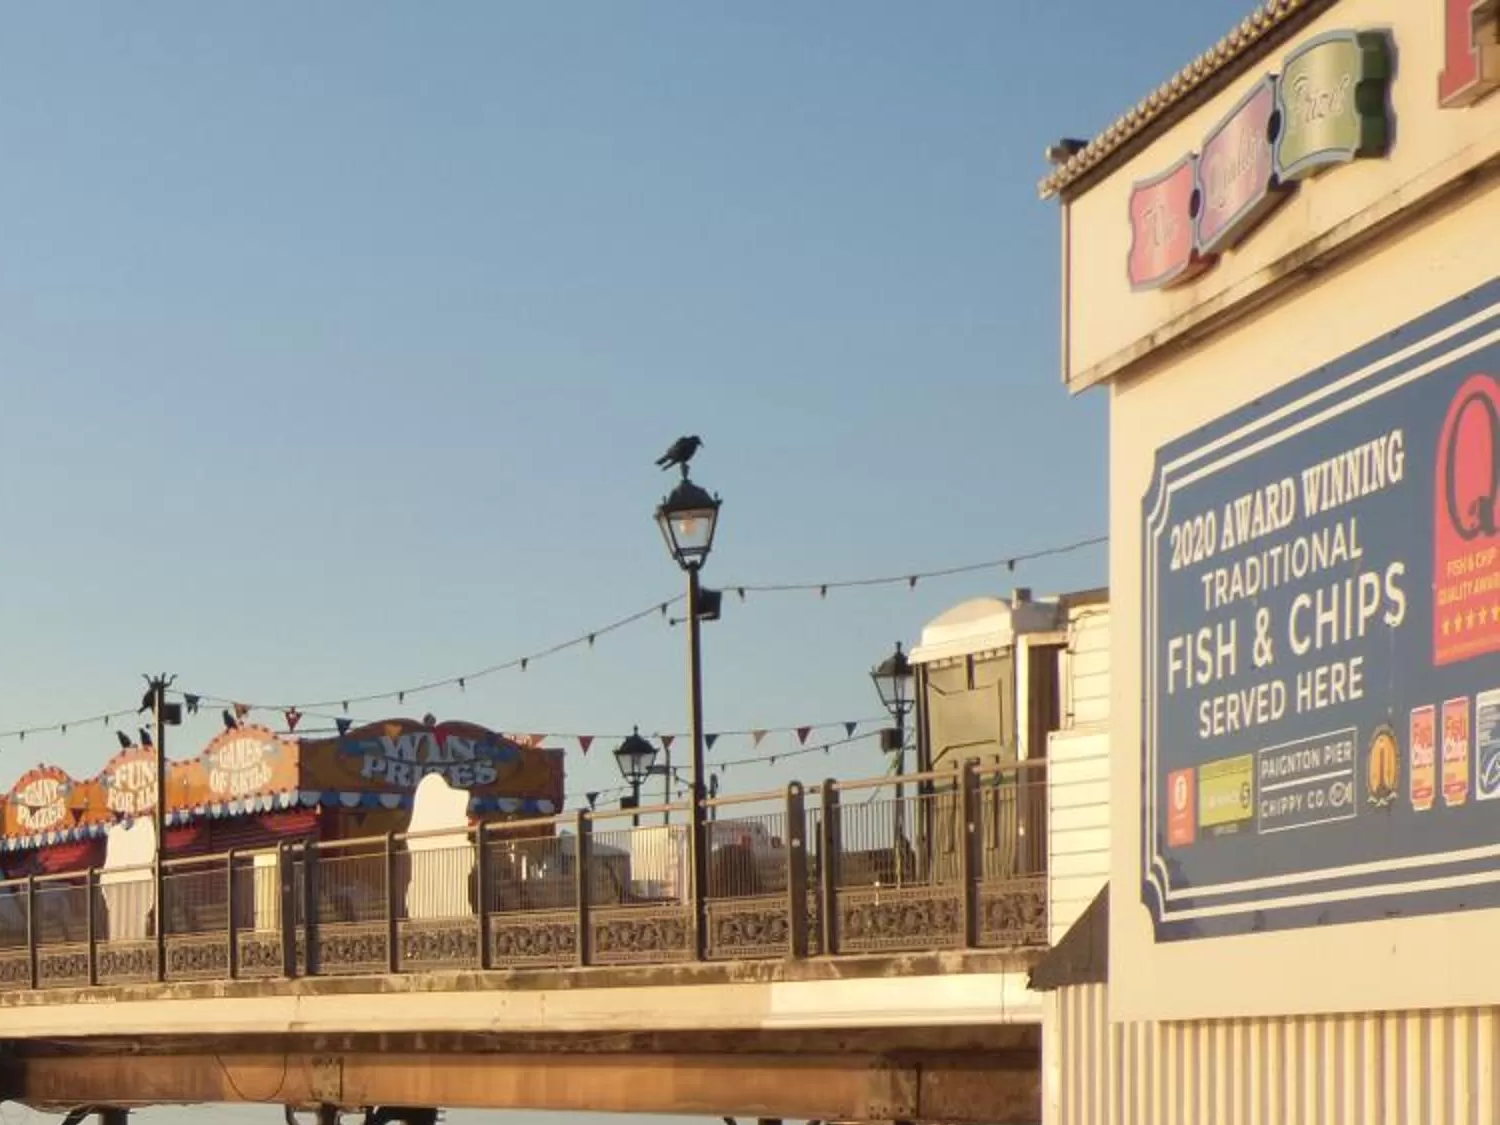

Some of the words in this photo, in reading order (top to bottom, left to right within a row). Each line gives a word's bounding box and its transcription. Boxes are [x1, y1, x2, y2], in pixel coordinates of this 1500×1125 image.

[1170, 509, 1217, 571] 2020
[1220, 477, 1296, 551] AWARD
[1301, 429, 1405, 518] WINNING
[1201, 517, 1364, 611] TRADITIONAL
[1167, 619, 1237, 695] FISH
[1252, 607, 1274, 668] &
[1288, 561, 1407, 656] CHIPS
[1198, 680, 1286, 739] SERVED
[1296, 656, 1364, 714] HERE
[380, 732, 477, 762] WIN
[1261, 747, 1321, 779] PAIGNTON
[1323, 741, 1353, 766] PIER
[114, 760, 156, 790] FUN
[360, 755, 498, 788] PRIES
[1261, 793, 1303, 819] CHIPPY
